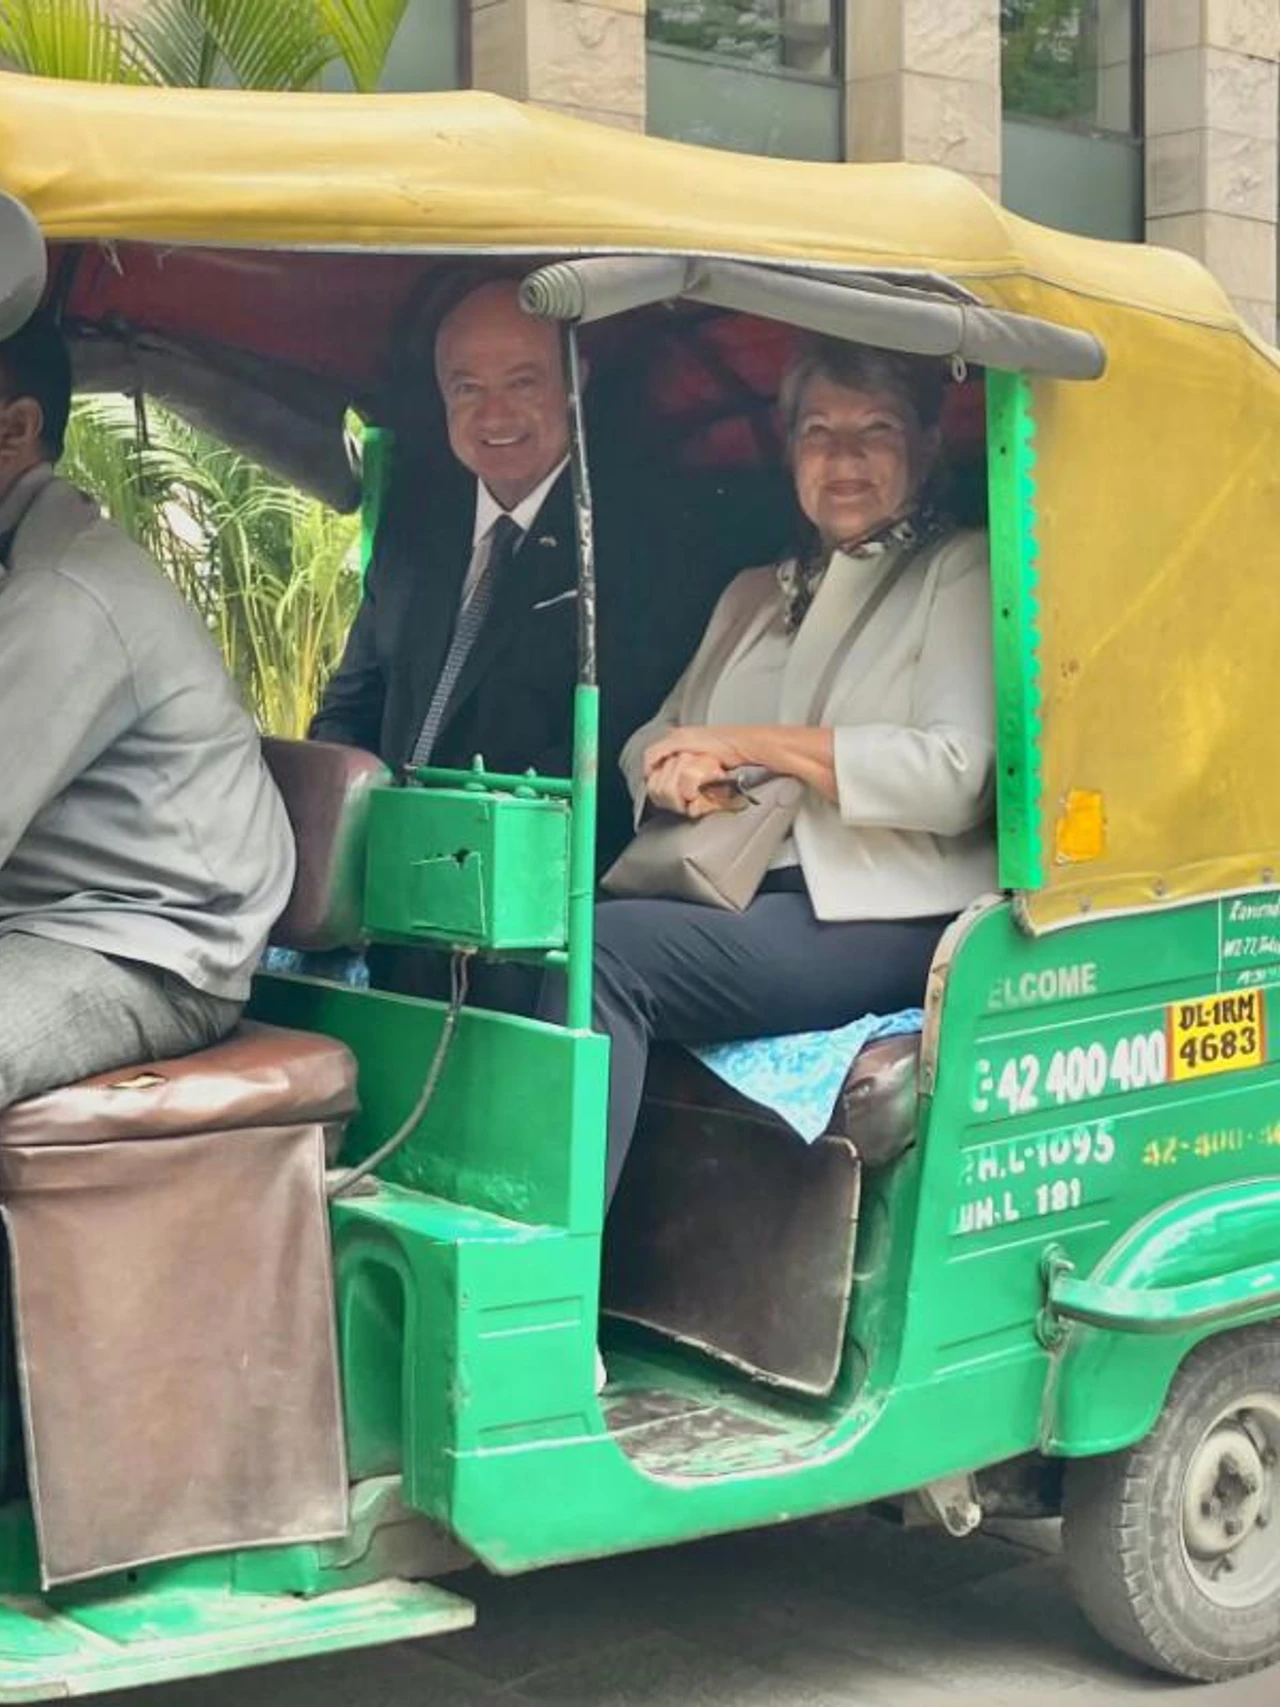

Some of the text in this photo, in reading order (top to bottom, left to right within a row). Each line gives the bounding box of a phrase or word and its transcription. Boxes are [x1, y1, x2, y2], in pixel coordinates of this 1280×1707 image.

[1045, 1042, 1108, 1104] 400
[1110, 1029, 1167, 1091] 400
[1180, 1027, 1256, 1068] 4683
[1036, 1177, 1082, 1216] 181
